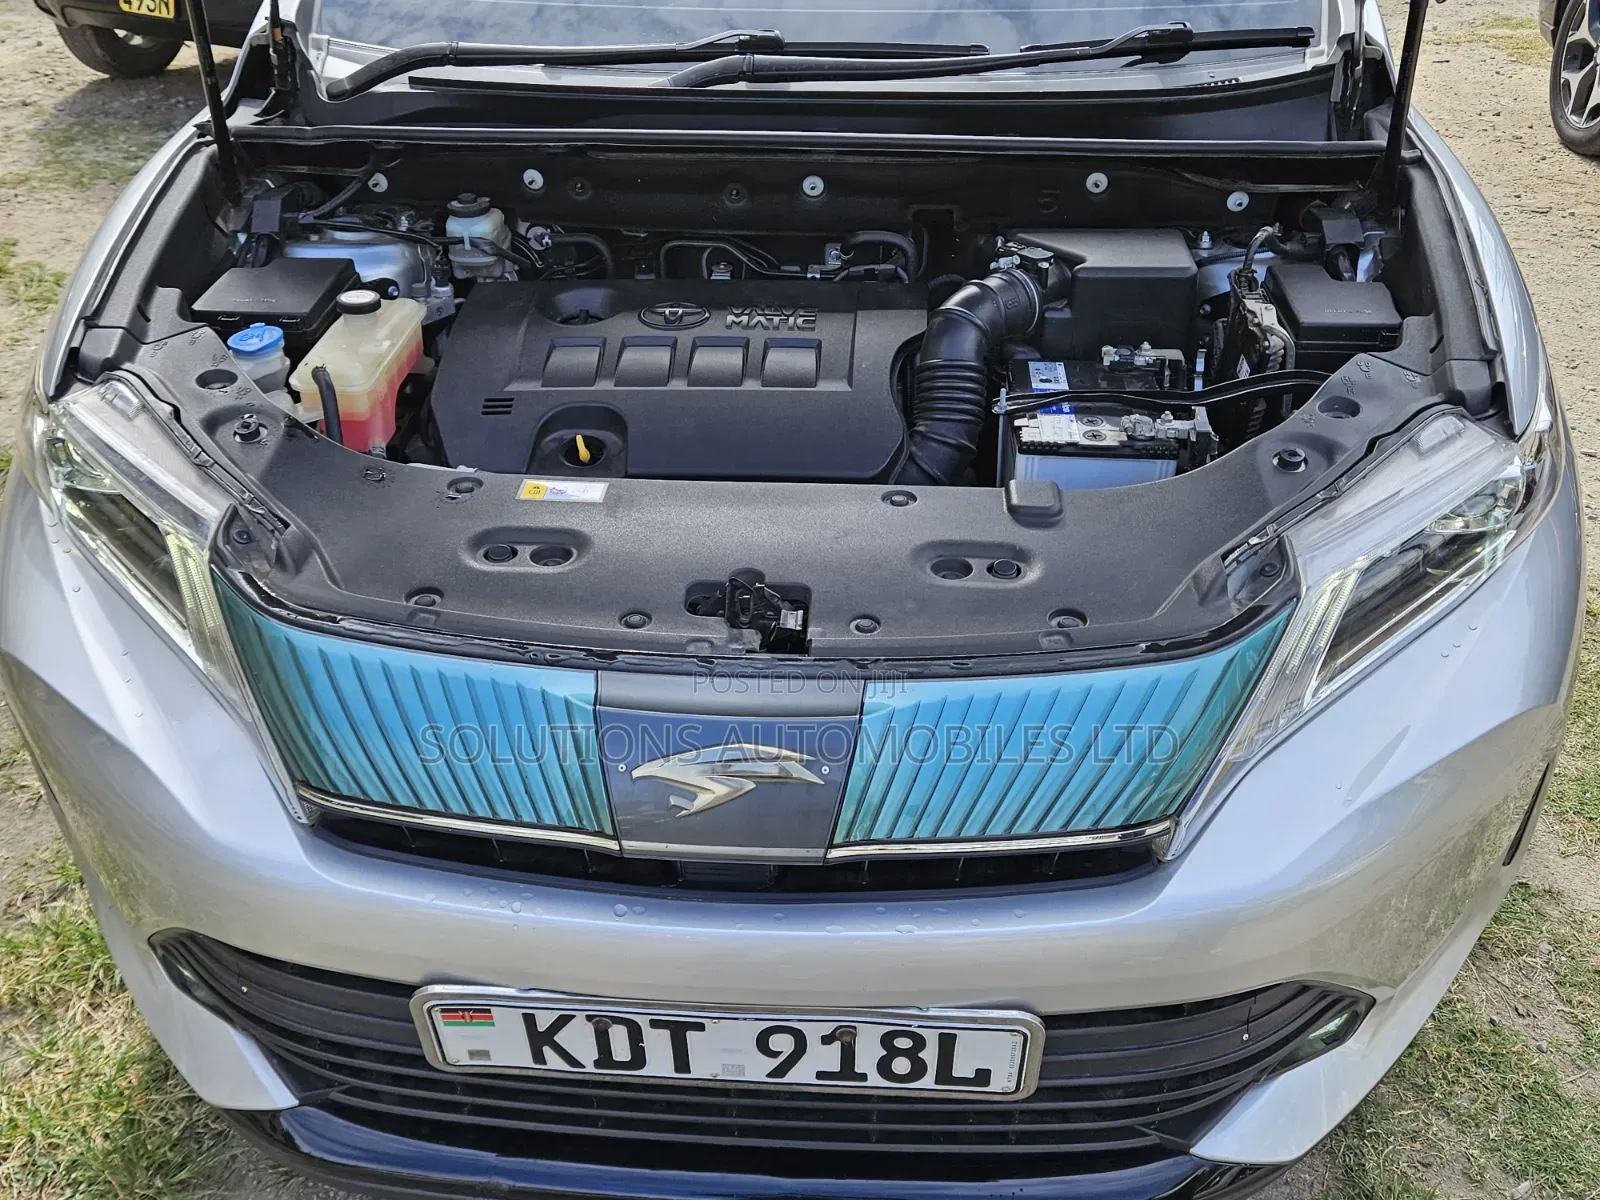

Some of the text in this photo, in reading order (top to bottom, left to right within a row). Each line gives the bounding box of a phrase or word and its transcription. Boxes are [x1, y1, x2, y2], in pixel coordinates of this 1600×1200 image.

[725, 315, 816, 332] MATIC
[521, 1012, 992, 1088] KDT 918L
